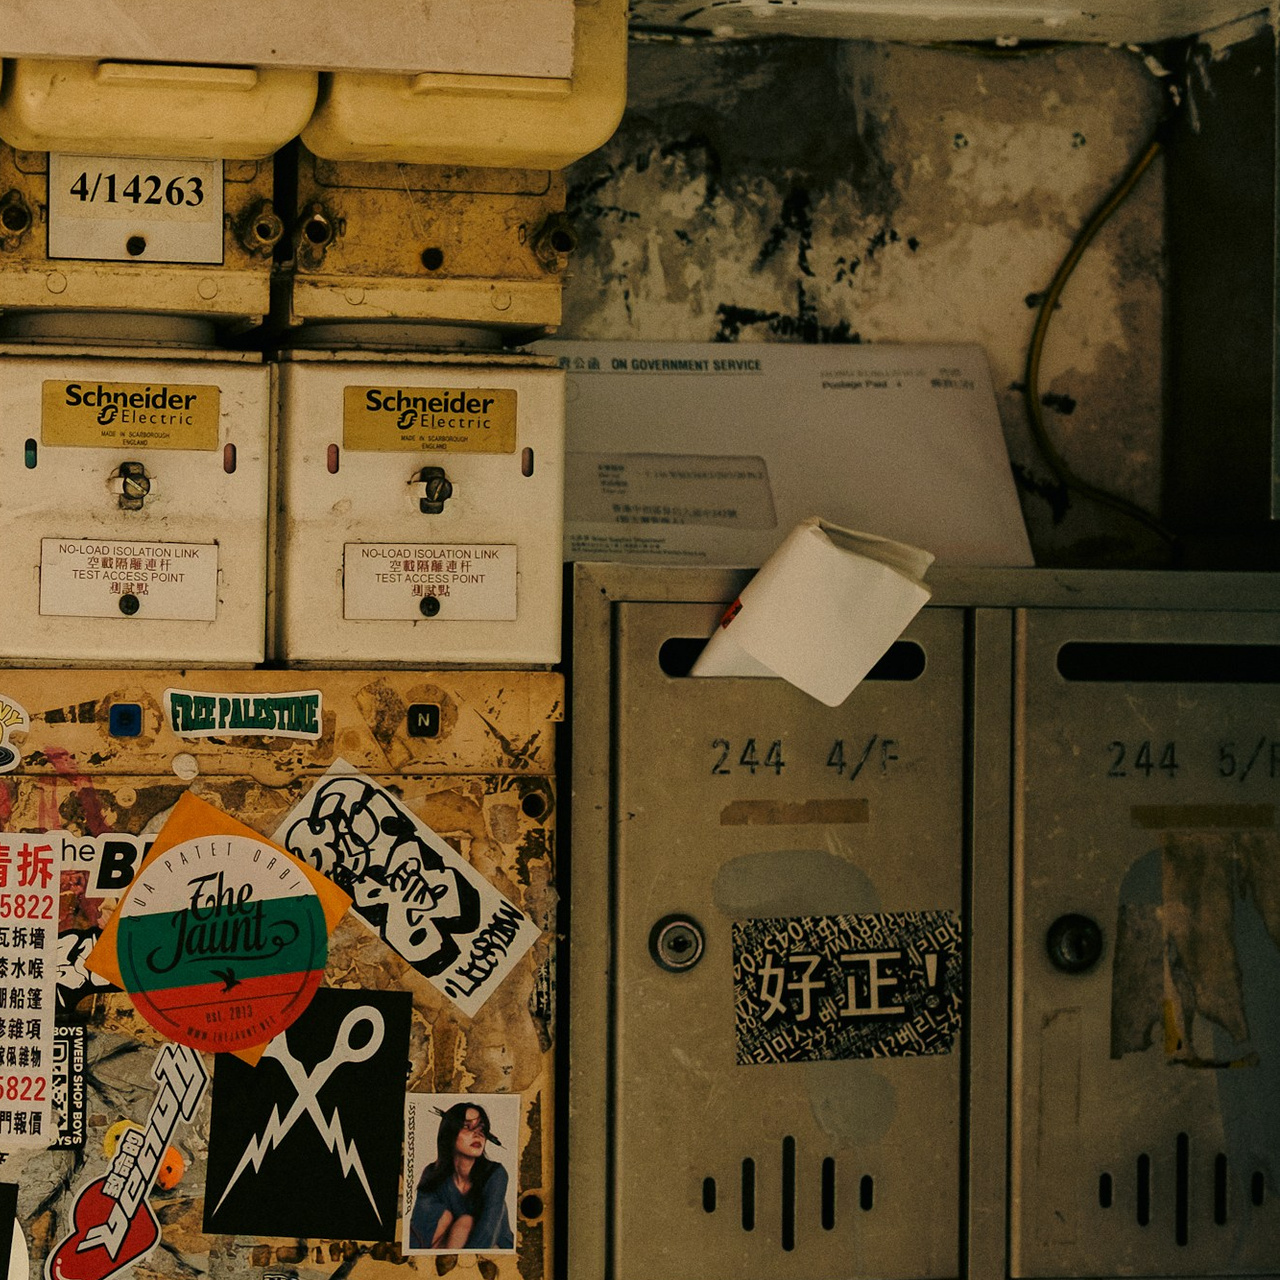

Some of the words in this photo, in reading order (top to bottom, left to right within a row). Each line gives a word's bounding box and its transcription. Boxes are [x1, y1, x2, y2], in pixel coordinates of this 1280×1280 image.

[70, 172, 205, 206] 4/14263
[612, 359, 627, 370] ON
[632, 359, 708, 371] GOVERNMENT
[713, 360, 761, 371] SERVICE
[66, 385, 197, 409] Schneider
[366, 390, 494, 413] Schneider
[122, 410, 193, 424] Electric
[421, 414, 490, 428] Electric
[59, 545, 109, 555] NO-LOAD
[113, 546, 171, 557] ISOLATION
[175, 548, 199, 558] LINK
[73, 570, 100, 579] TEST
[103, 571, 148, 581] ACCESS
[152, 573, 185, 582] POINT
[171, 693, 216, 732] FREE
[218, 694, 318, 734] PALESTINE
[713, 736, 786, 777] 244
[826, 735, 899, 779] 4/F
[1106, 740, 1177, 778] 244
[0, 894, 53, 919] 5822
[187, 871, 253, 921] The
[146, 900, 286, 973] Jaunt
[73, 1037, 83, 1073] WEED
[73, 1075, 83, 1109] SHOP
[73, 1112, 83, 1144] BOYS
